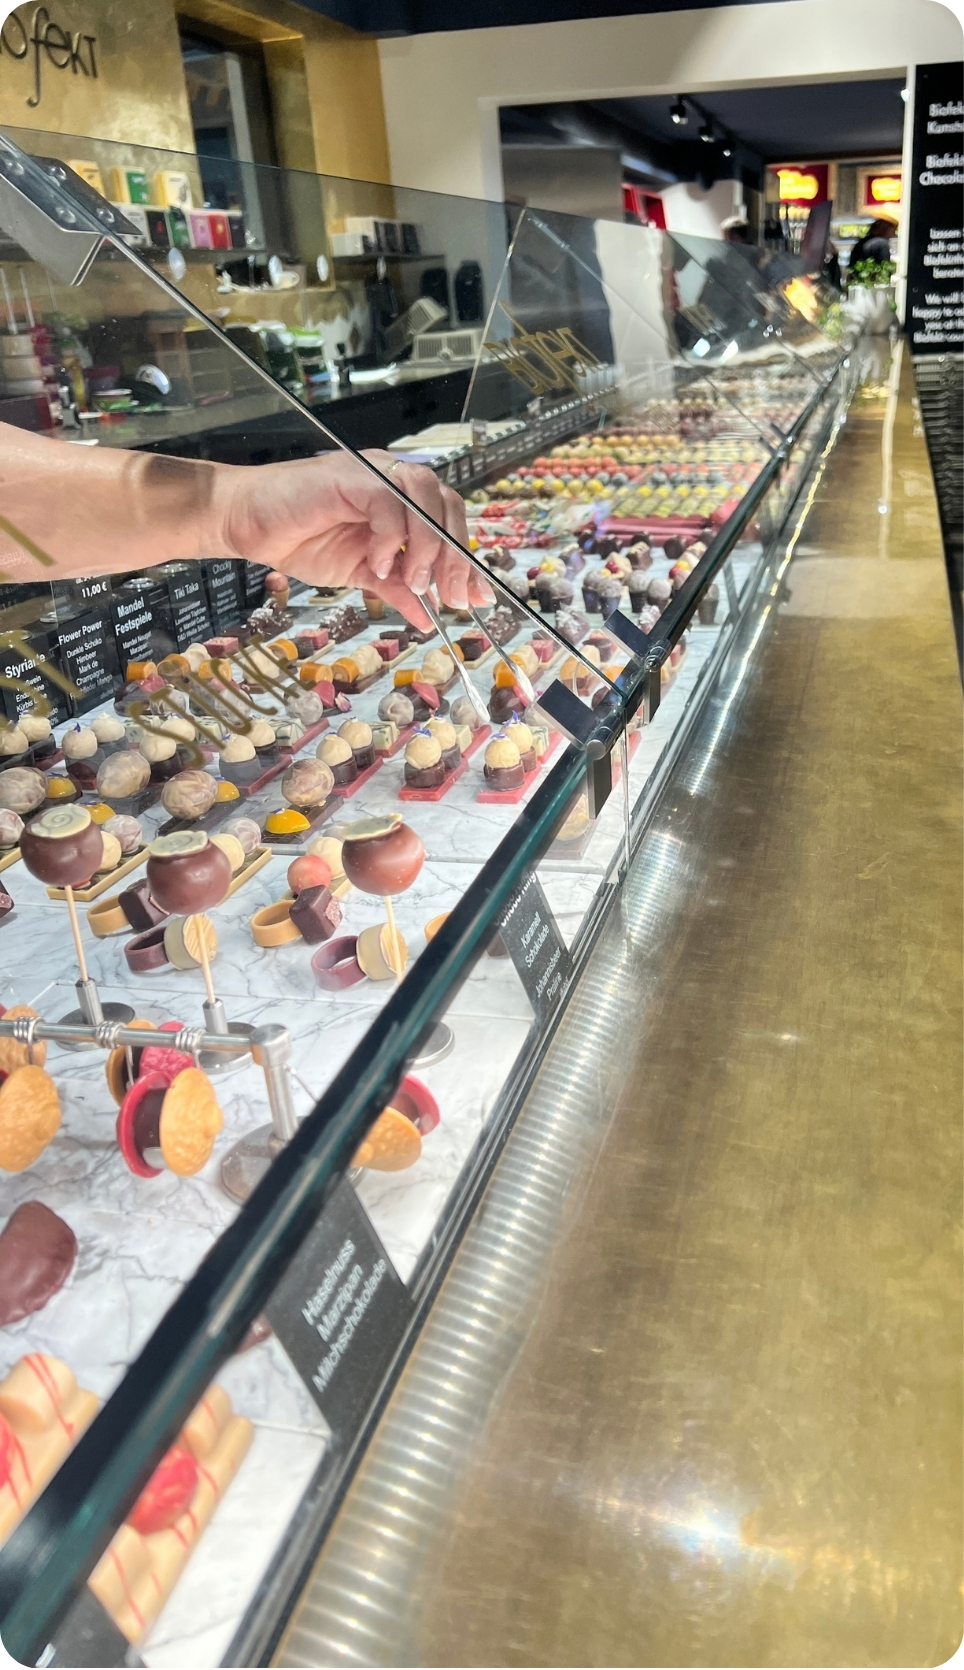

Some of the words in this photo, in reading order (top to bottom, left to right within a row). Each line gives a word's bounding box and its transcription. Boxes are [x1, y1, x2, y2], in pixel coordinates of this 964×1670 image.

[81, 583, 101, 598] 11,00
[117, 596, 145, 618] Mandel
[58, 629, 82, 646] Flower
[81, 620, 103, 636] Power
[114, 611, 153, 636] Festspiele
[66, 646, 85, 659] Dunkle
[84, 637, 103, 651] Schoko
[76, 650, 97, 665] Himbeer
[75, 668, 105, 686] Champagne
[78, 664, 91, 675] Mark
[524, 924, 550, 968] Schokolade
[535, 946, 562, 998] Johannisbeer
[546, 971, 562, 1002] Praline
[302, 1239, 356, 1327] Haselnuss
[316, 1263, 364, 1343] Marzipan
[311, 1258, 387, 1394] Milchschokolade
